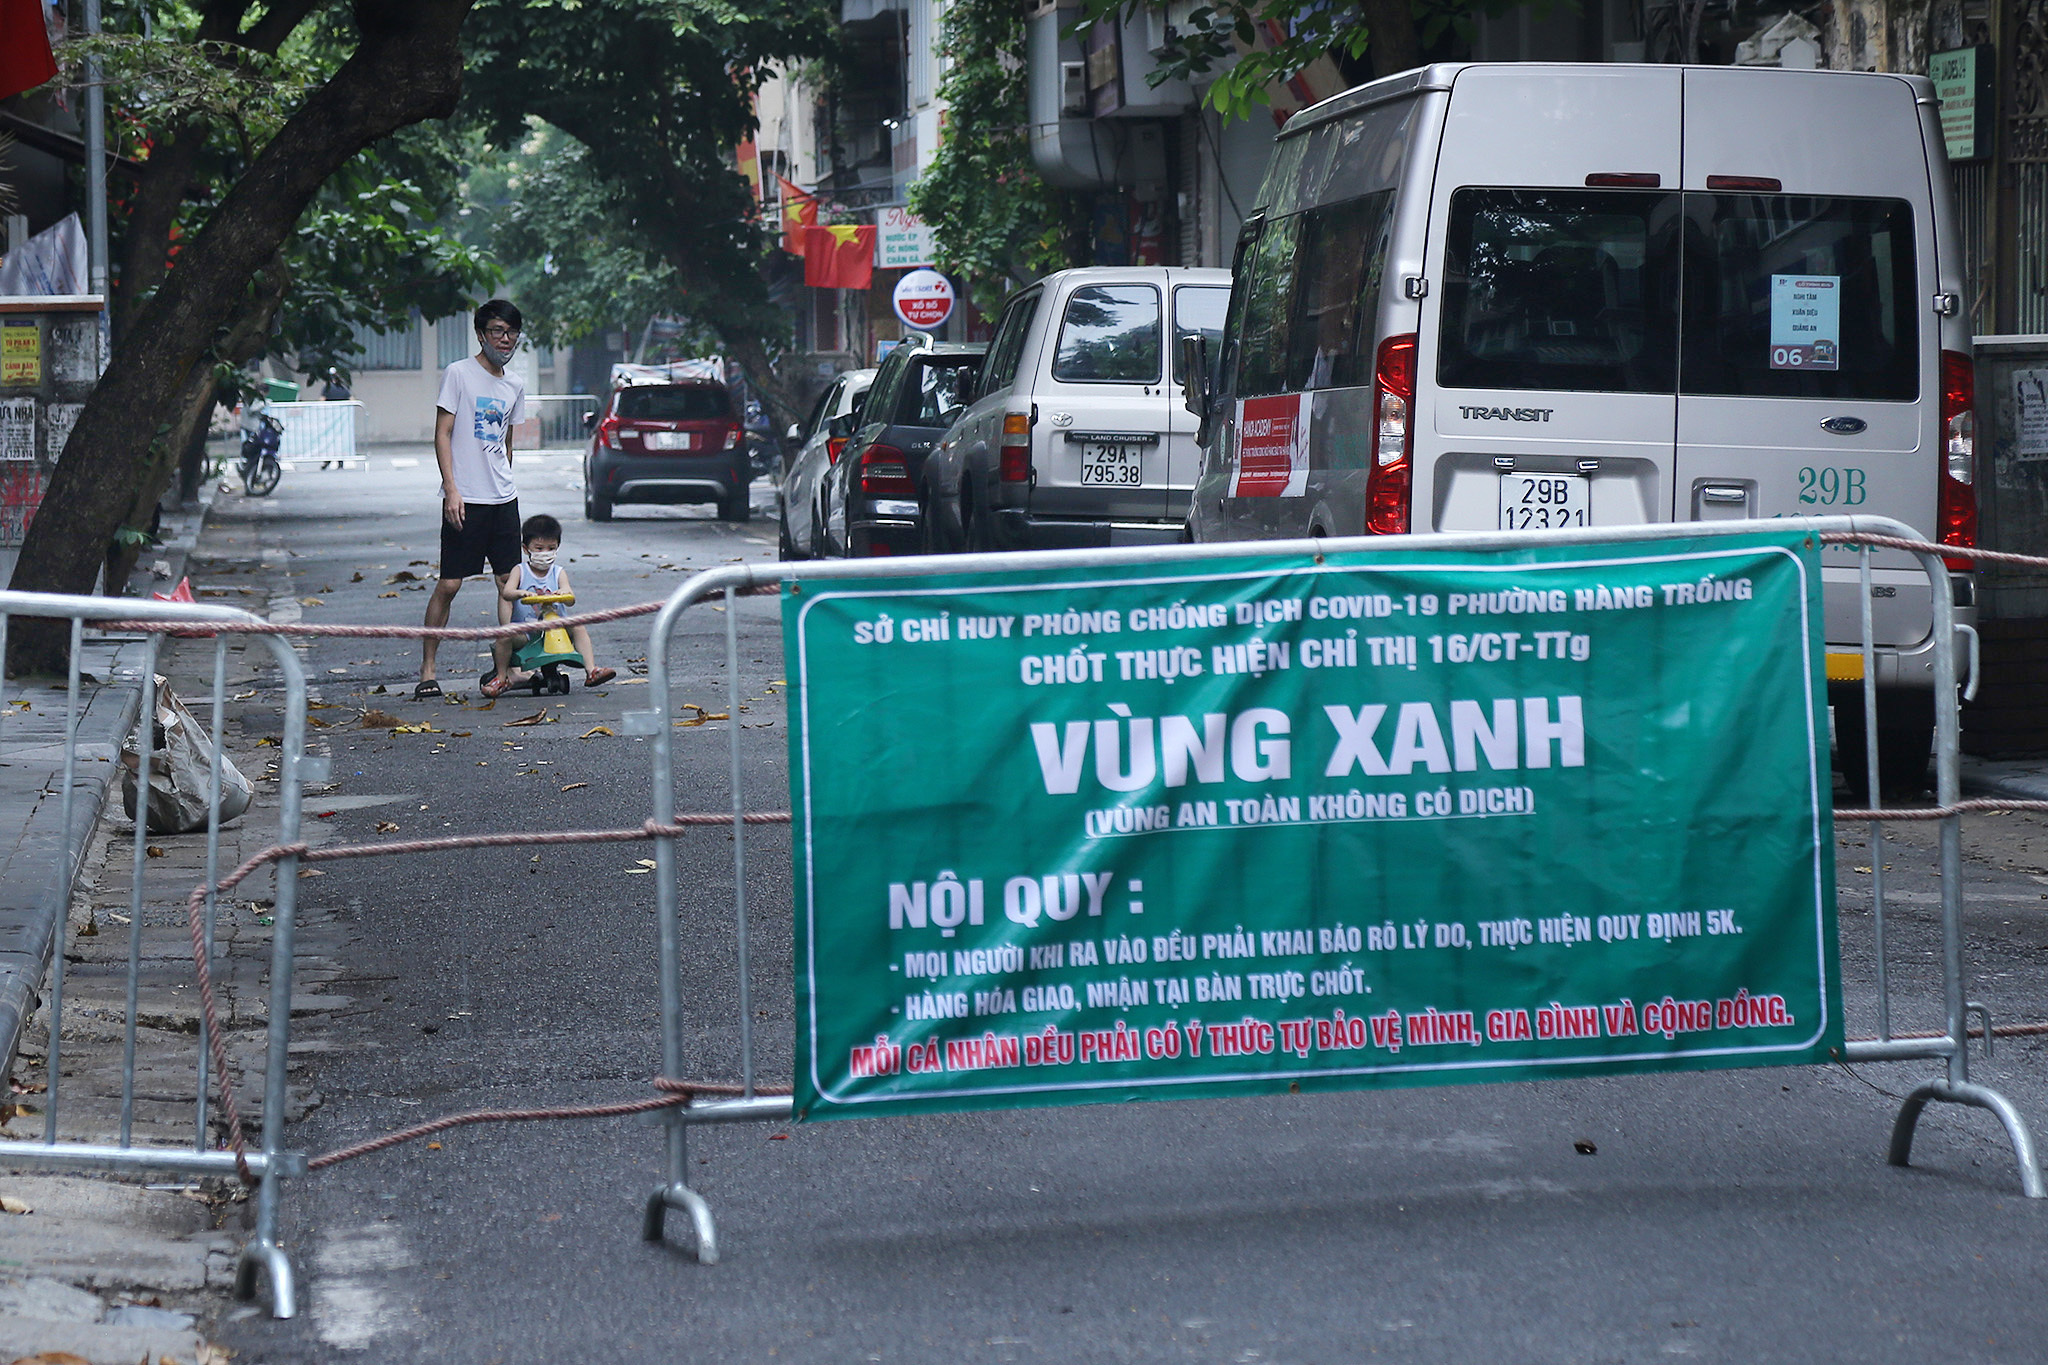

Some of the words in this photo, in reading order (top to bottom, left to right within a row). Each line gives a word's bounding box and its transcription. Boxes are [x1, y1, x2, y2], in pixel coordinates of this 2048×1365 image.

[1773, 348, 1803, 366] 06
[1459, 405, 1554, 423] TRANSIT
[1084, 464, 1140, 484] 795.38
[1096, 444, 1128, 463] 29A
[1521, 478, 1569, 505] 29B
[1798, 466, 1867, 506] 29B
[855, 614, 894, 644] SỞ
[902, 612, 949, 642] CHỈ
[958, 617, 1014, 639] HUY
[1024, 608, 1120, 636] PHÒNG
[1130, 600, 1227, 631] CHỐNG
[1235, 598, 1302, 628] DỊCH
[1310, 595, 1438, 619] COVID-19
[1449, 586, 1566, 614] PHƯỜNG
[1575, 584, 1653, 610] HÀNG
[1661, 574, 1752, 605] TRỐNG
[1021, 644, 1106, 685] CHỐT
[1115, 646, 1202, 684] THỰC
[1213, 635, 1289, 677] HIỆN
[1300, 629, 1357, 668] CHỈ
[1366, 636, 1416, 670] THỊ
[1428, 632, 1589, 663] 16/CT-TTg
[1030, 703, 1290, 796] VÙNG
[1324, 696, 1584, 776] XANH
[1085, 803, 1170, 837] (VÙNG
[1178, 802, 1217, 826] AN
[1225, 794, 1303, 825] TOÀN
[1310, 790, 1411, 822] KHÔNG
[1416, 787, 1451, 816] CÓ
[1457, 787, 1535, 818] DỊCH)
[890, 871, 983, 937] NỘI
[1005, 871, 1112, 928] QUY
[906, 952, 947, 982] MỌI
[955, 942, 1023, 975] NGƯỜI
[1032, 945, 1062, 968] KHI
[1071, 942, 1098, 966] RA
[1104, 935, 1147, 964] VÀO
[1154, 929, 1196, 961] ĐỀU
[1203, 926, 1255, 958] PHẢI
[1262, 931, 1313, 956] KHAI
[1320, 923, 1361, 953] BÁO
[1369, 922, 1396, 950] RÕ
[1404, 920, 1428, 948] LÝ
[1436, 924, 1471, 948] DO,
[1479, 918, 1532, 950] THỰC
[1539, 913, 1591, 947] HIỆN
[1599, 915, 1640, 942] QUY
[1648, 912, 1700, 942] ĐỊNH
[1708, 910, 1742, 934] 5K.
[907, 991, 968, 1020] HÀNG
[976, 988, 1016, 1014] HÓA
[1023, 985, 1081, 1011] GIAO,
[1087, 977, 1148, 1011] NHẬN
[1155, 979, 1189, 1008] TẠI
[1196, 972, 1241, 1001] BÀN
[1248, 971, 1304, 1003] TRỰC
[1312, 962, 1371, 996] CHỐT.
[851, 1035, 902, 1079] MỖI
[907, 1037, 943, 1074] CÁ
[946, 1032, 1020, 1071] NHÂN
[1023, 1024, 1074, 1066] ĐỀU
[1079, 1020, 1141, 1063] PHẢI
[1145, 1021, 1181, 1059] CÓ
[1181, 1020, 1202, 1058] Ý
[1207, 1017, 1274, 1056] THỨC
[1278, 1017, 1313, 1058] TỰ
[1315, 1009, 1367, 1050] BẢO
[1370, 1009, 1403, 1053] VỆ
[1407, 1007, 1482, 1046] MÌNH,
[1486, 1009, 1533, 1042] GIA
[1536, 1002, 1600, 1039] ĐÌNH
[1602, 999, 1639, 1036] VÀ
[1643, 997, 1712, 1039] CỘNG
[1716, 989, 1794, 1029] ĐỒNG.
